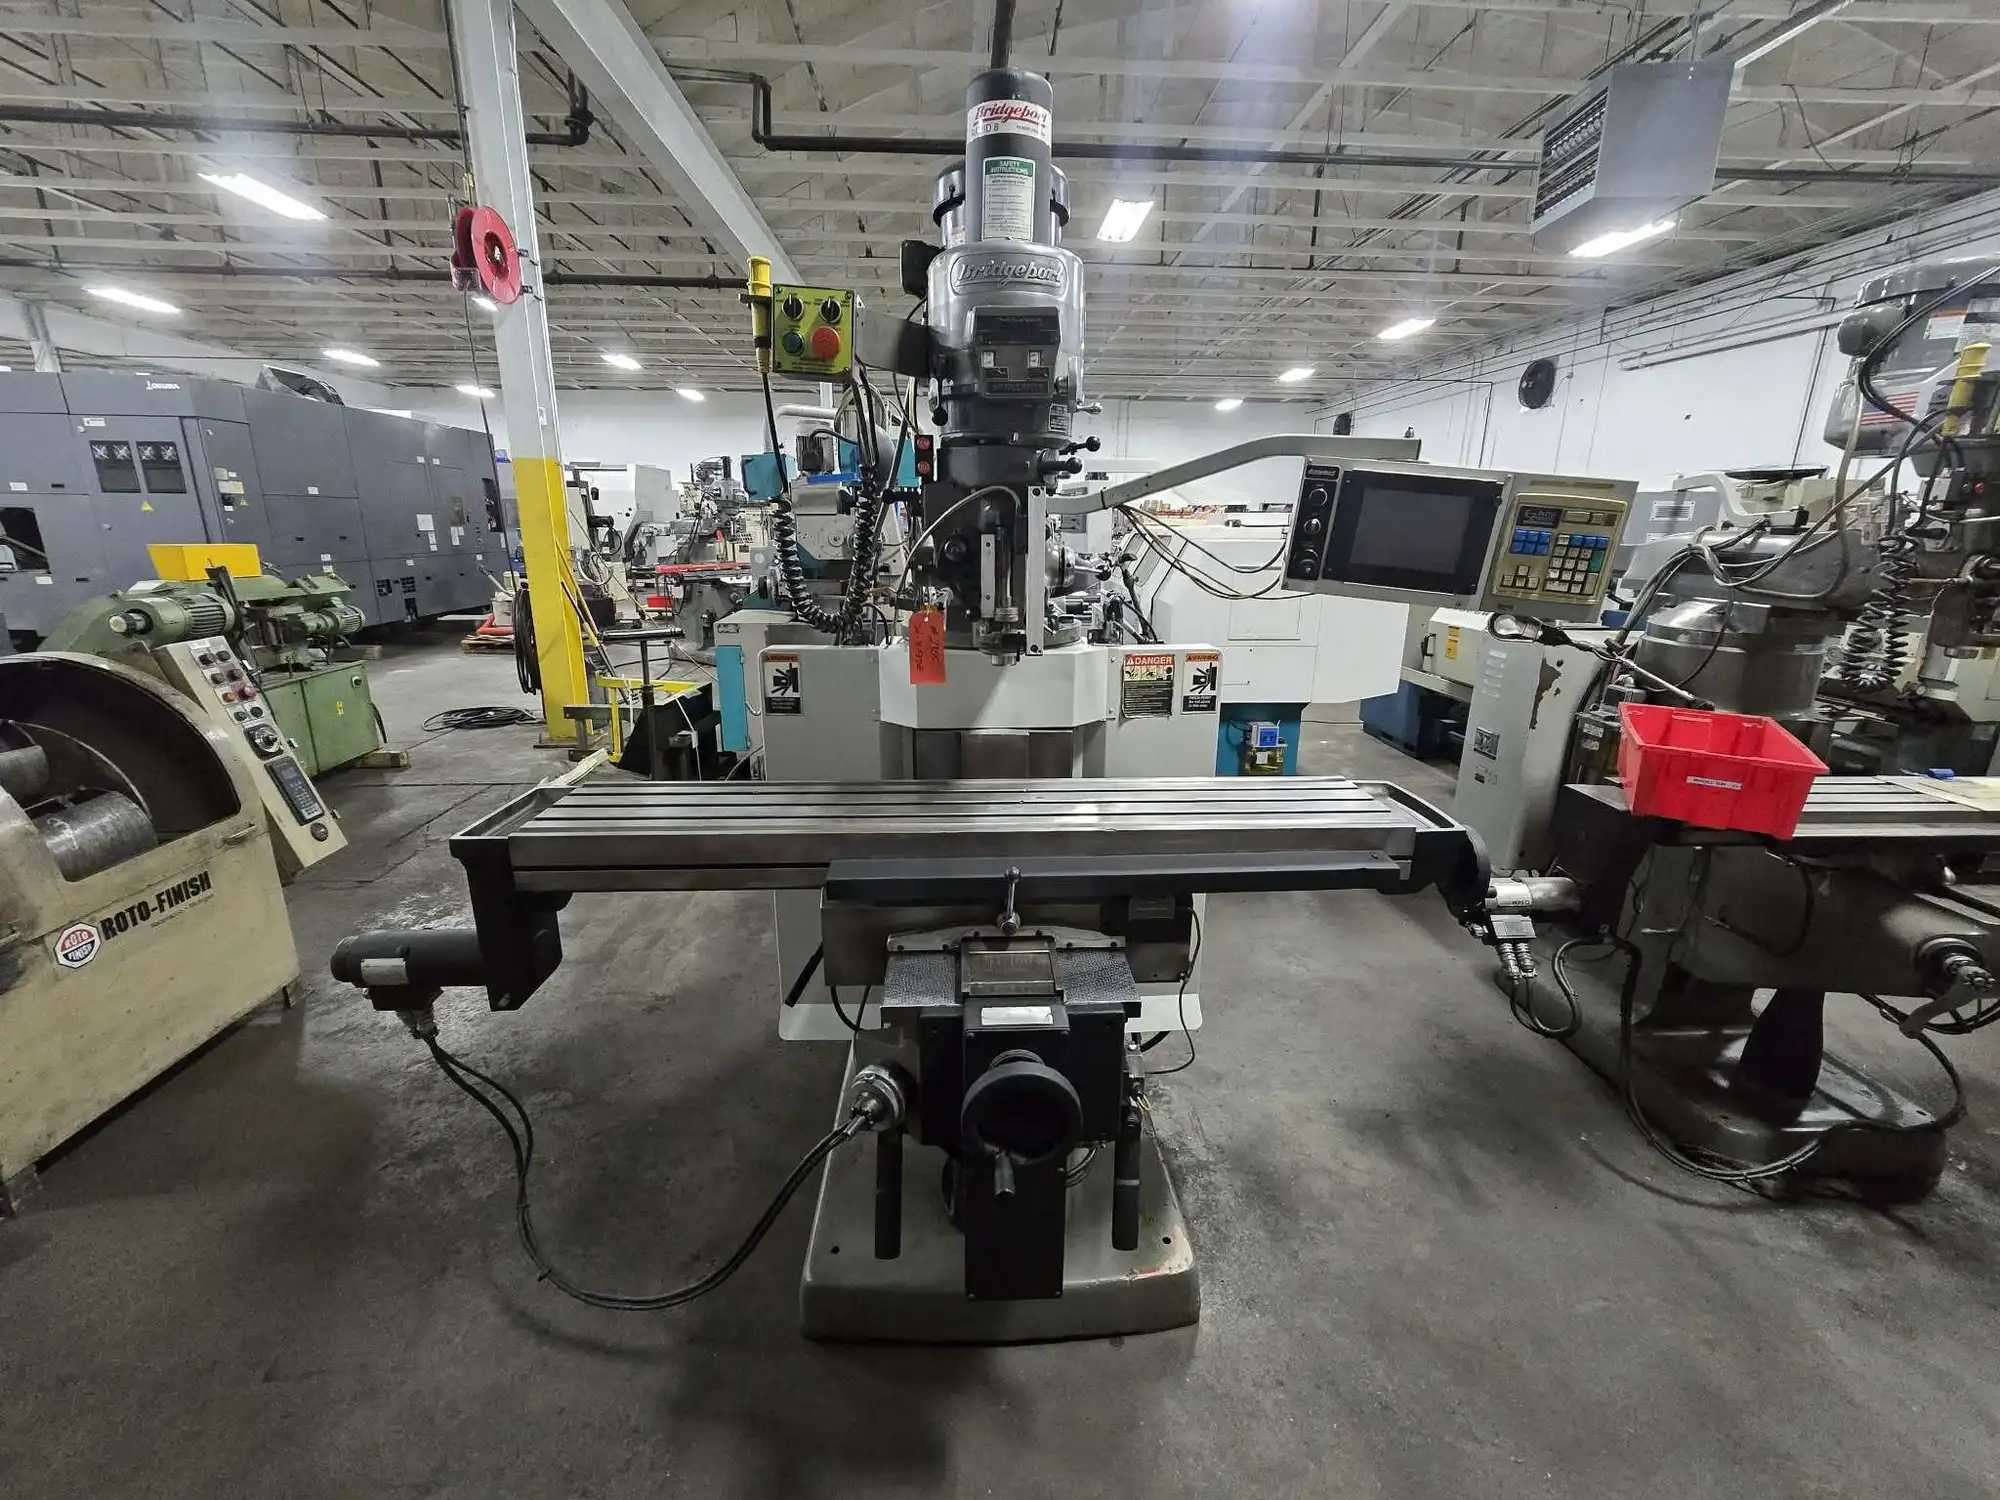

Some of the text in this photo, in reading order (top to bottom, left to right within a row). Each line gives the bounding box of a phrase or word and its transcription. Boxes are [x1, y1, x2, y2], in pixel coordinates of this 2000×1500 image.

[975, 102, 1048, 123] Bridgeport
[957, 259, 1064, 286] Bridgeport
[1134, 656, 1172, 665] DANGER
[99, 871, 213, 941] ROTO-FINISH
[67, 943, 93, 962] FINISH
